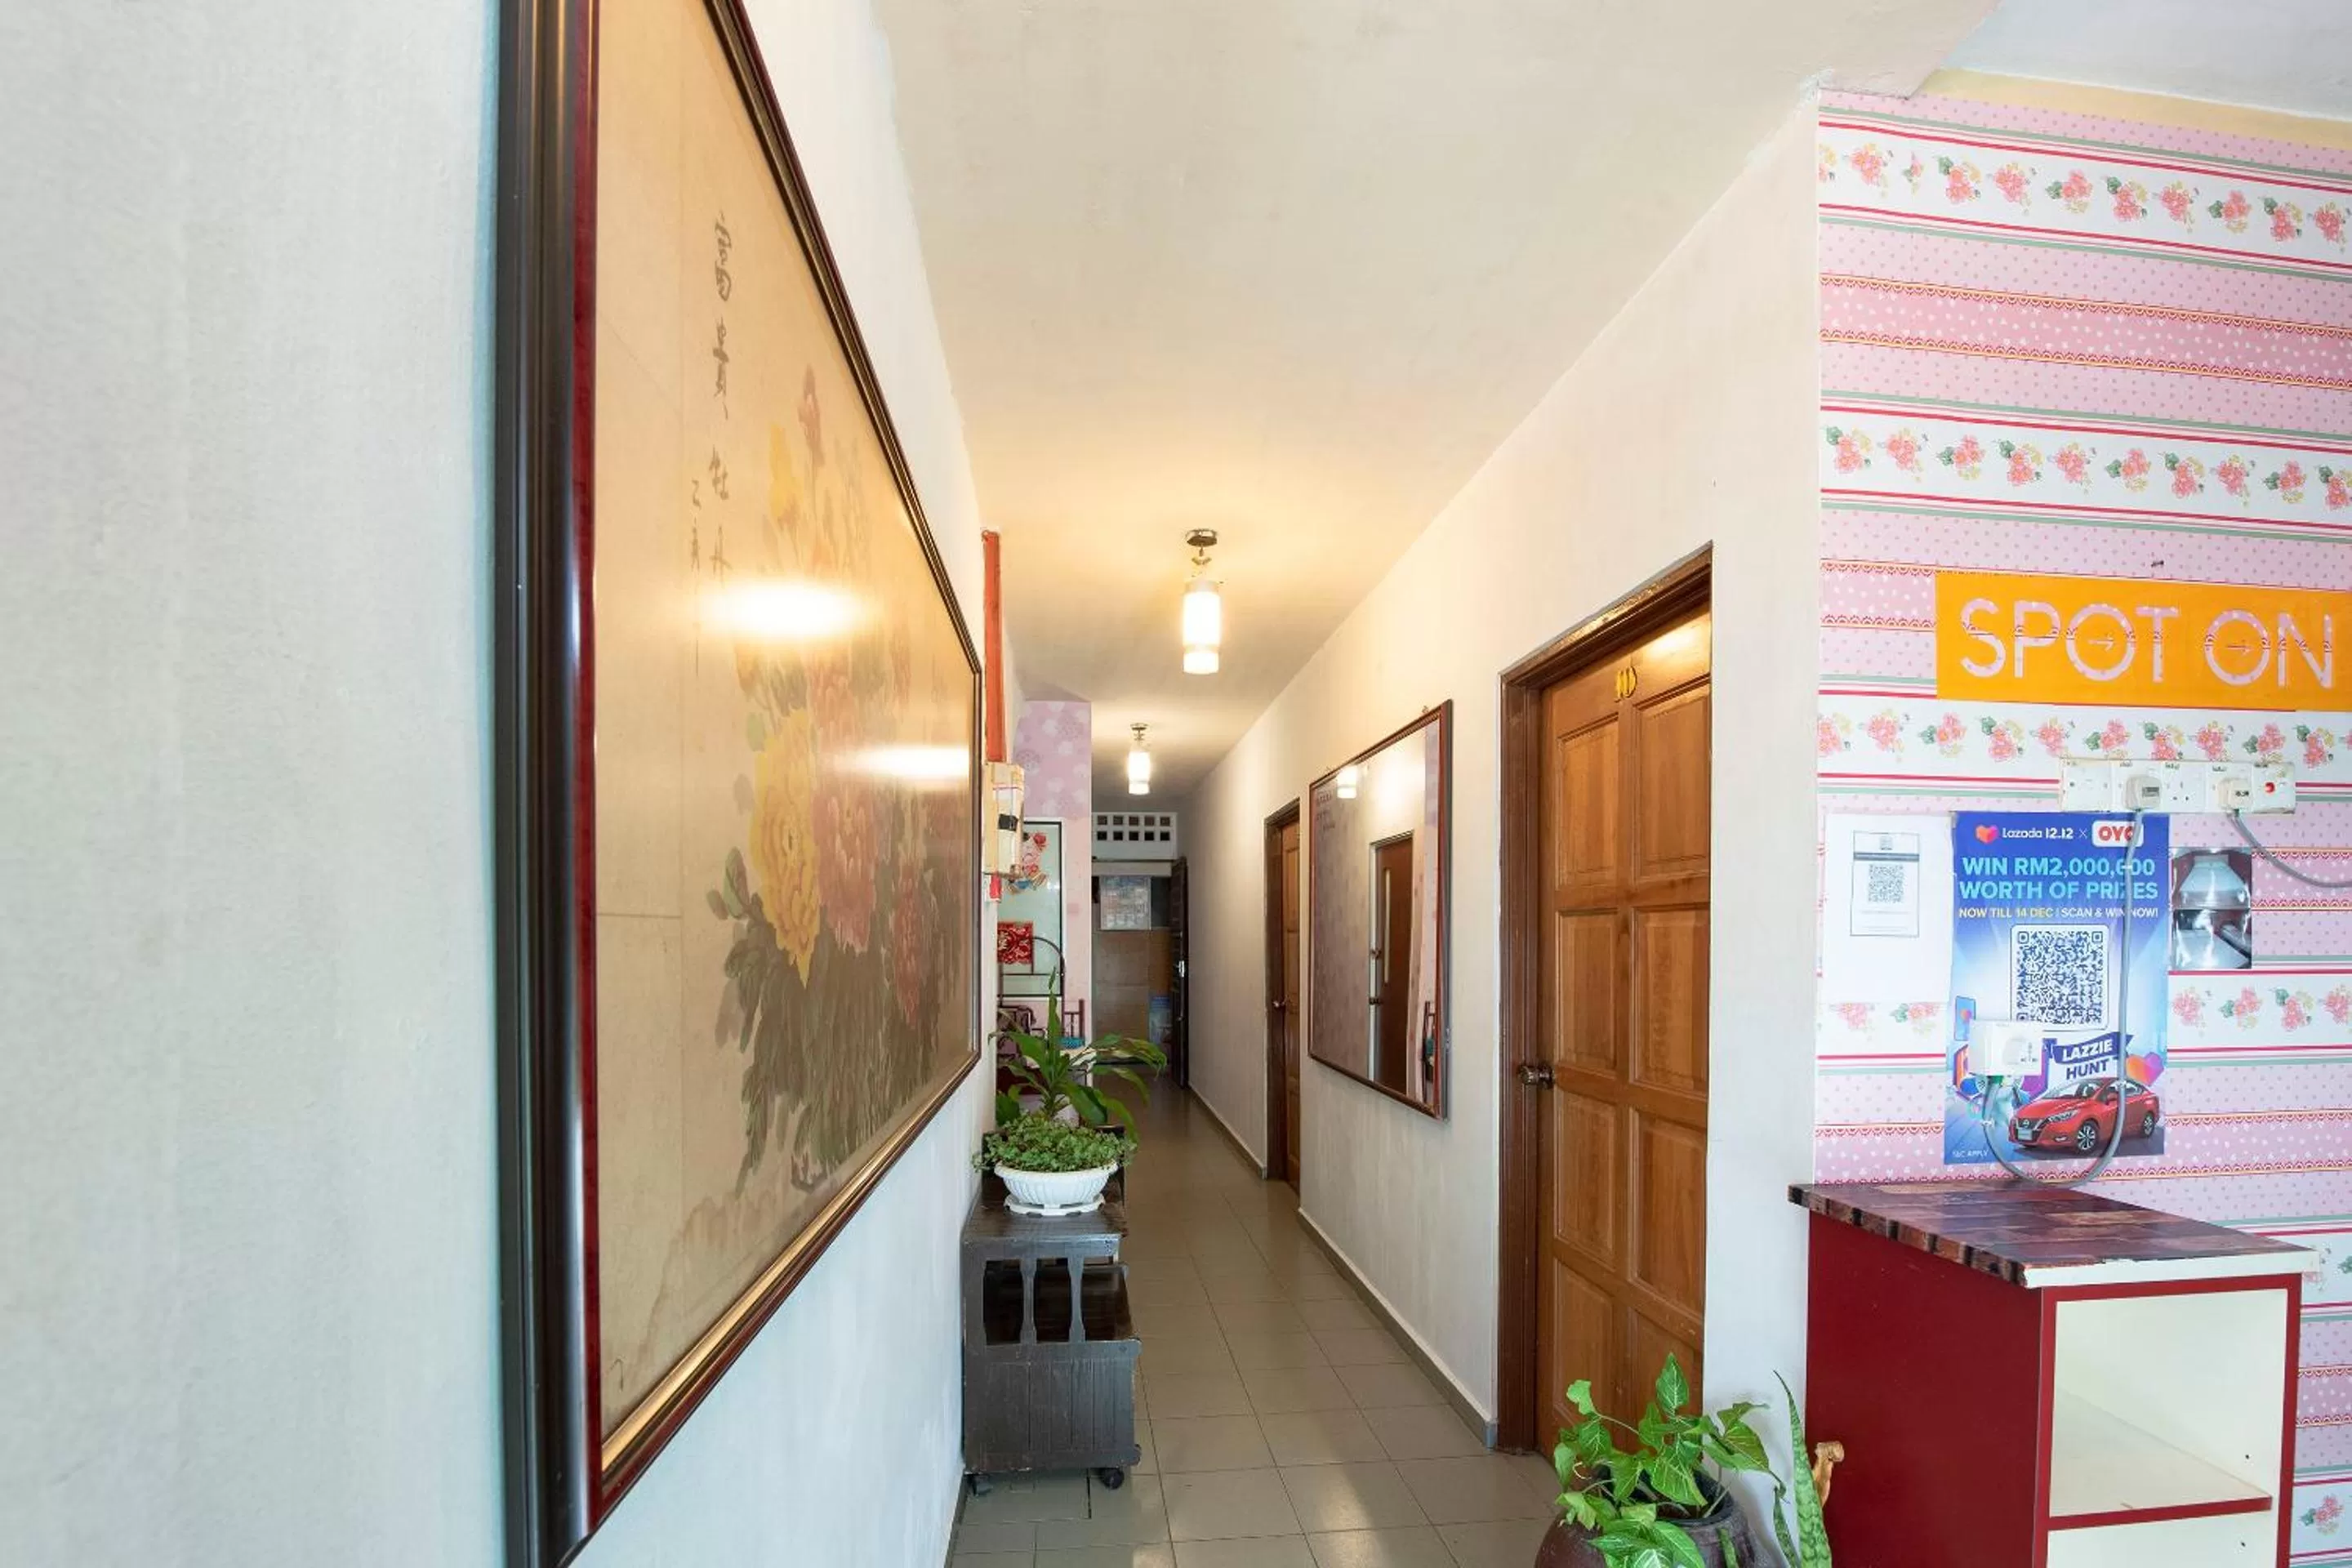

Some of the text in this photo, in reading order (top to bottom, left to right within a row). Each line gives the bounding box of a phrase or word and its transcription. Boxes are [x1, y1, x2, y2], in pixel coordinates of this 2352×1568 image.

[1959, 597, 2333, 689] SPOT ON
[2002, 826, 2042, 839] Lazada
[2045, 826, 2074, 840] 12.12
[1962, 857, 2007, 876] WIN
[1960, 881, 2041, 899] WORTH
[2048, 882, 2079, 899] OF
[1959, 907, 1987, 919] NOW
[1990, 907, 2012, 919] TILL
[2029, 908, 2054, 919] DEC
[2060, 907, 2092, 919] SCAN
[2095, 908, 2102, 918] &
[2062, 1038, 2113, 1062] LAZZIE
[2066, 1058, 2109, 1080] HUNT
